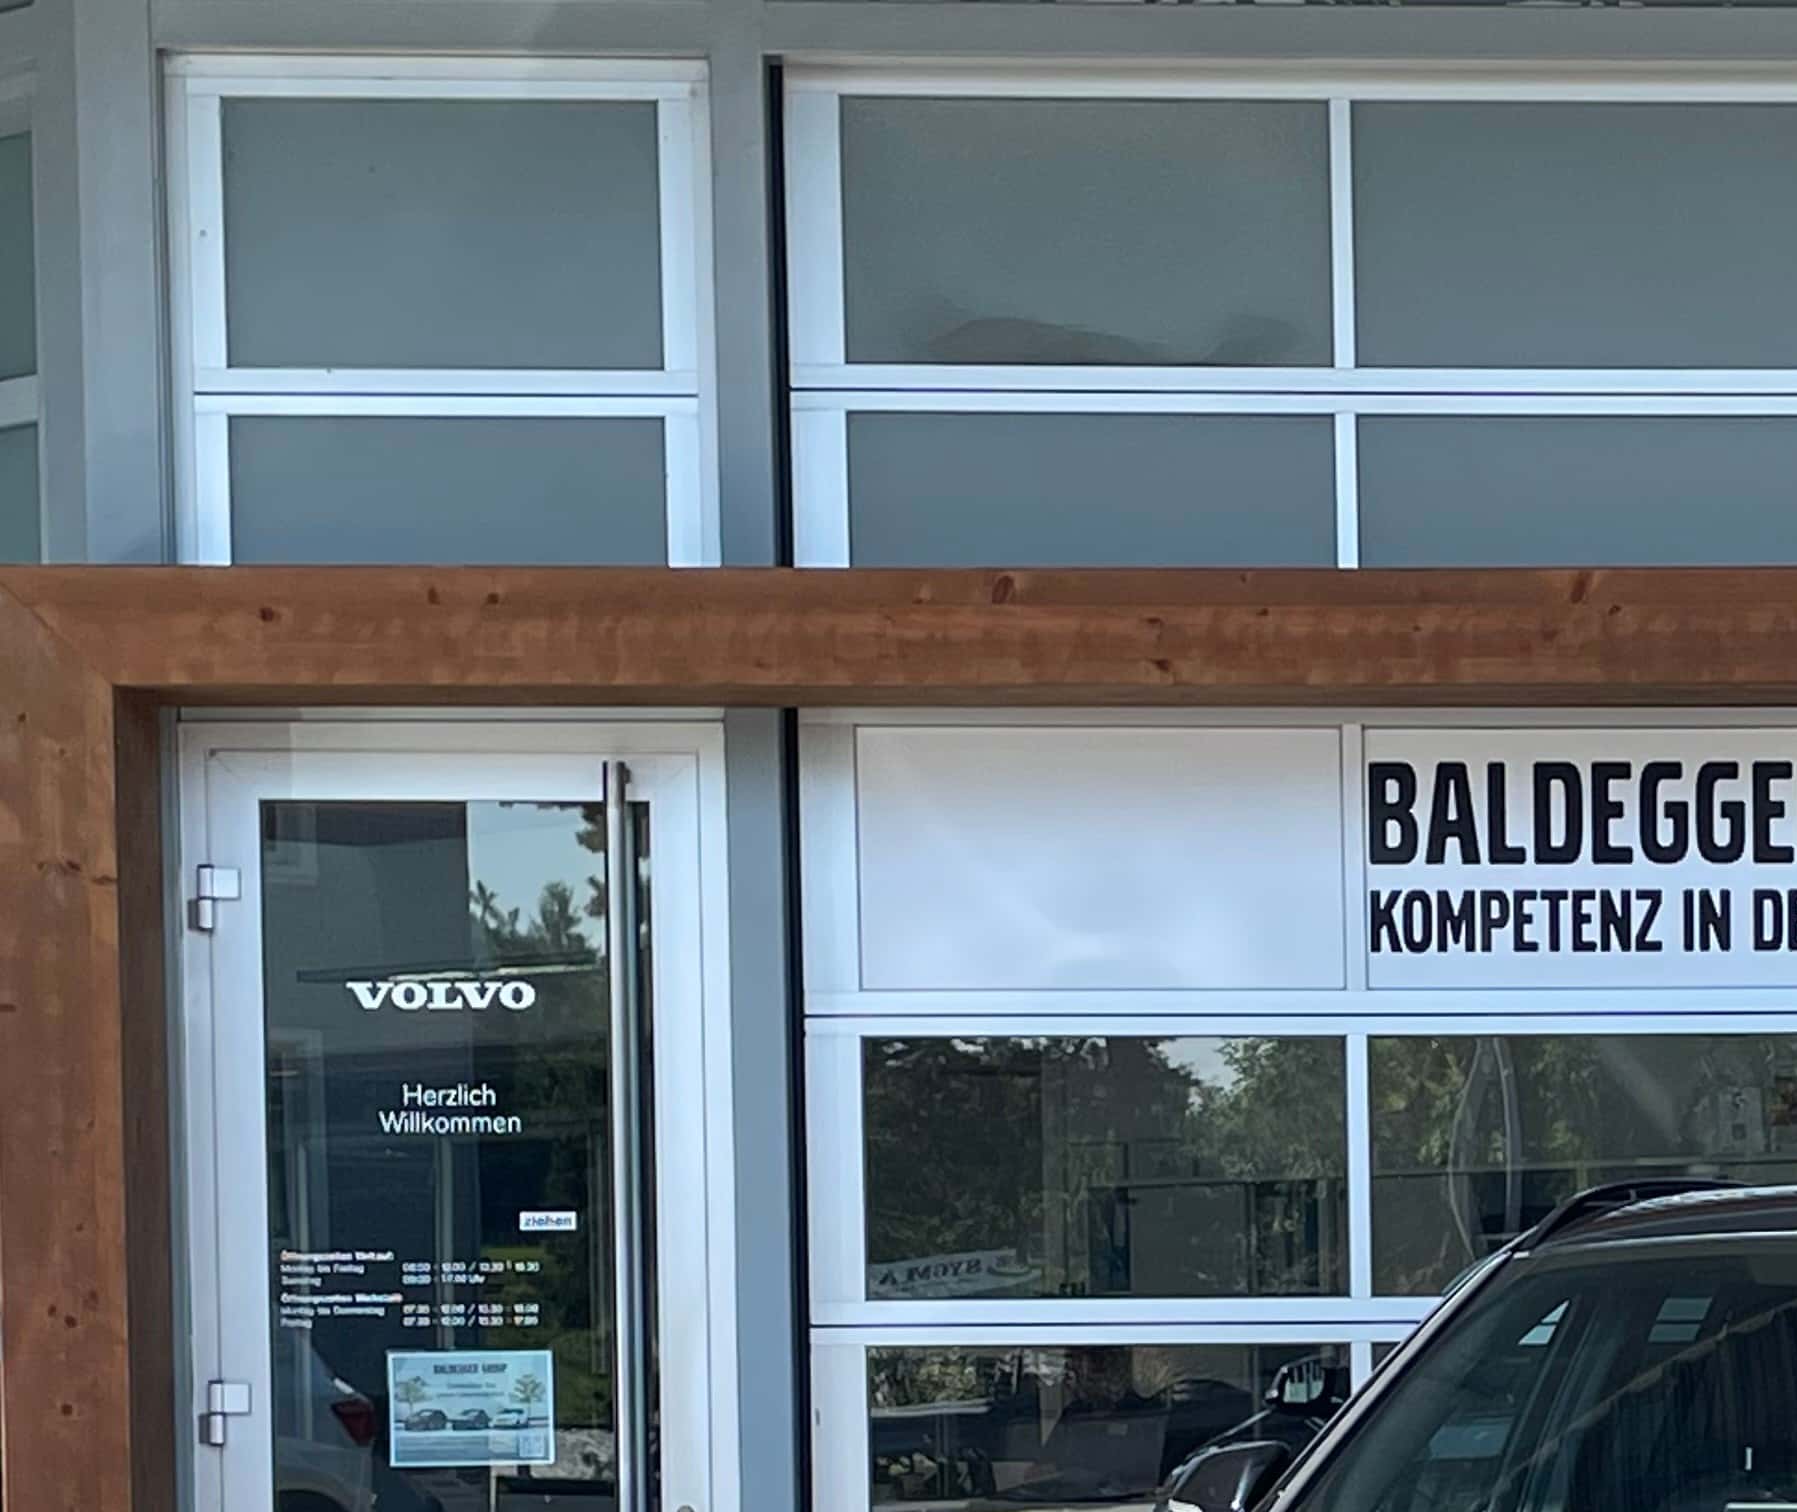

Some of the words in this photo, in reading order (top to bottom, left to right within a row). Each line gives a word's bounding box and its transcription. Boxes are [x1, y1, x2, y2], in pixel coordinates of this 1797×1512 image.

[1369, 888, 1663, 953] KOMPETENZ
[1683, 888, 1732, 952] IN
[345, 980, 537, 1011] VOLVO
[401, 1082, 497, 1107] Herzlich
[377, 1110, 523, 1134] Willkommen
